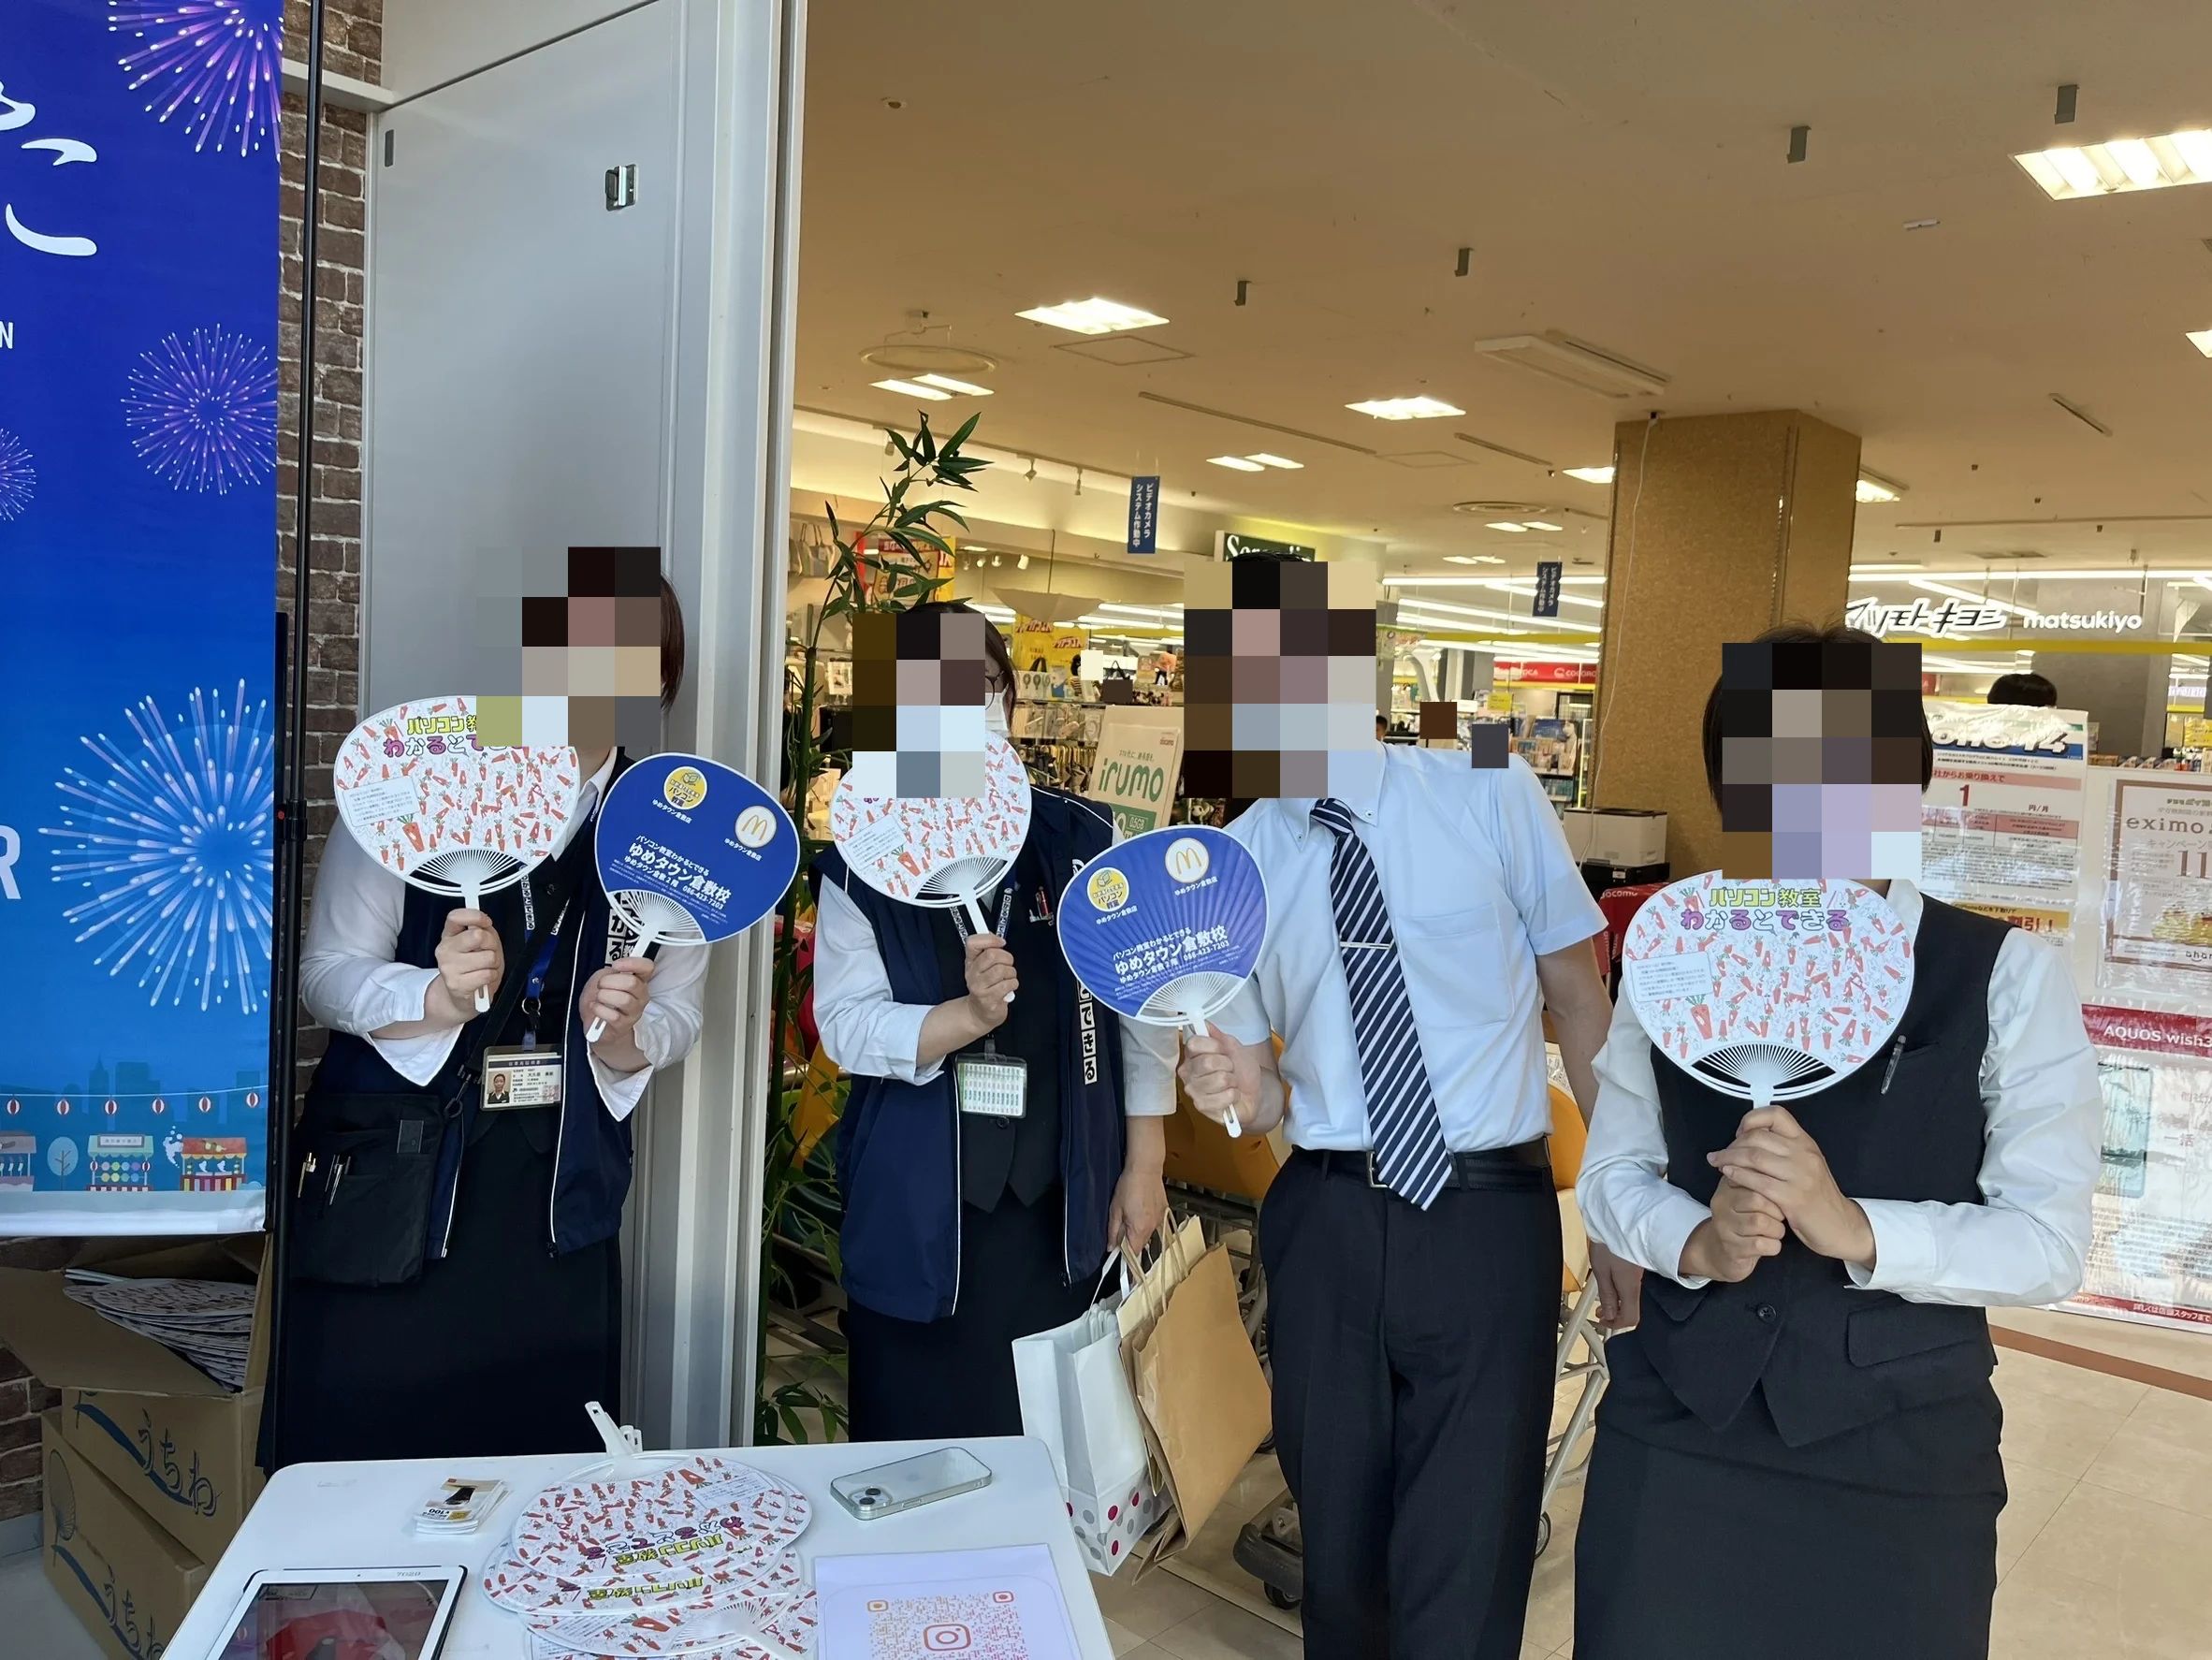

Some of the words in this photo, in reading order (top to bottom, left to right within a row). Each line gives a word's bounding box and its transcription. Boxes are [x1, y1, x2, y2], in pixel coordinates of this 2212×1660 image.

[1143, 483, 1154, 539] ビデオカメラ
[2023, 610, 2142, 633] matsukiyo
[407, 716, 476, 735] パソコン
[1099, 758, 1164, 802] irumo
[1959, 783, 1971, 808] 1
[2126, 816, 2205, 835] eximo
[629, 842, 732, 904] ゆめタウン倉敷校
[1709, 887, 1822, 908] パソコン教室
[1681, 910, 1850, 932] わかるとできる
[1114, 925, 1228, 975] ゆめタウン倉敷校
[2104, 1025, 2161, 1042] AQUOS
[138, 1406, 224, 1517] うちわ
